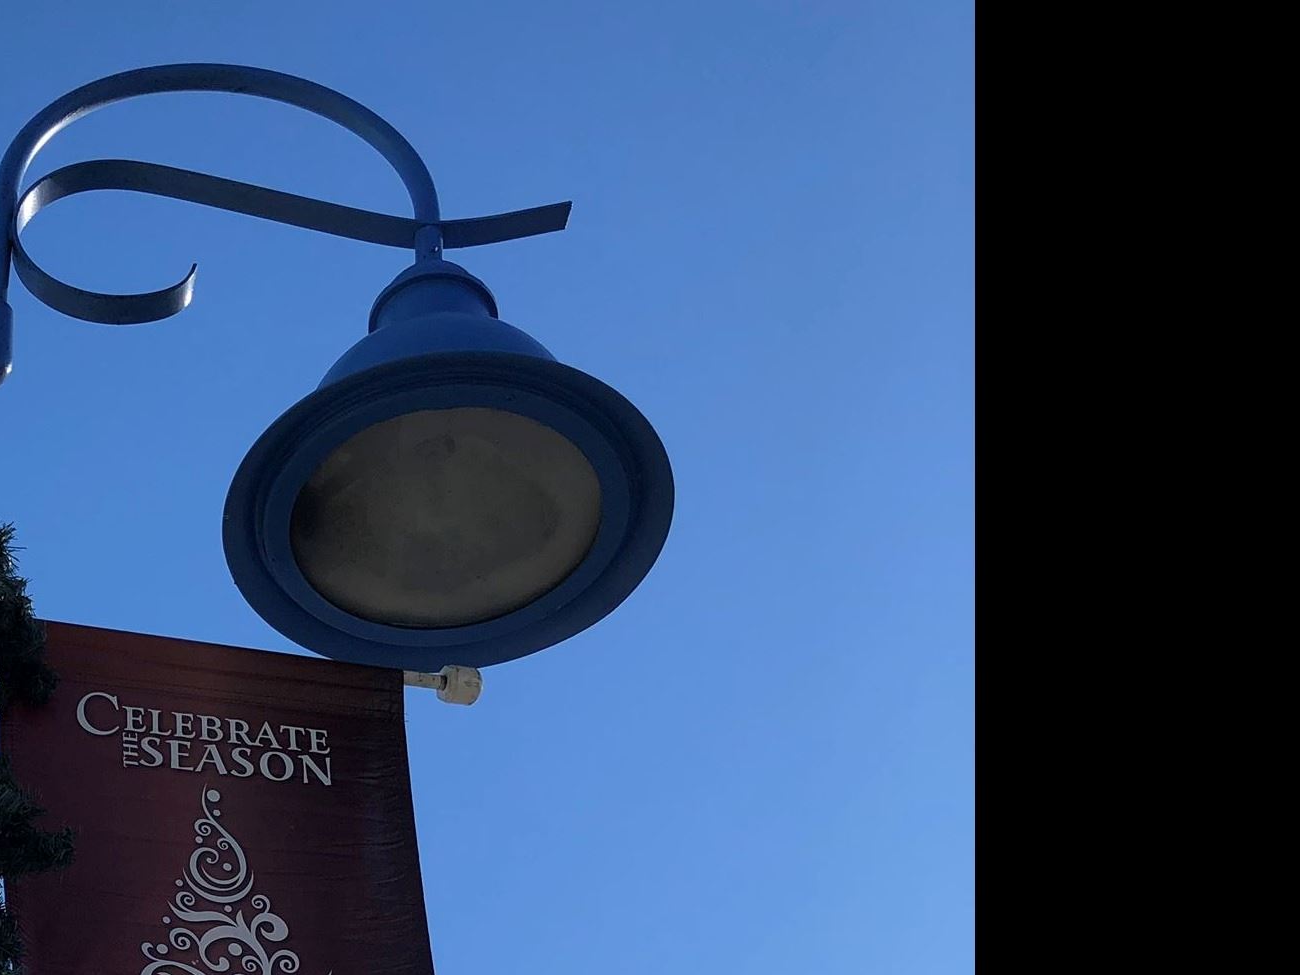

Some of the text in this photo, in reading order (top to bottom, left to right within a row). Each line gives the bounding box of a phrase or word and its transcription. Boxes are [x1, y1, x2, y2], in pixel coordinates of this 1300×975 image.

[76, 692, 331, 754] CELEBRATE
[123, 731, 332, 786] THE SEASON
